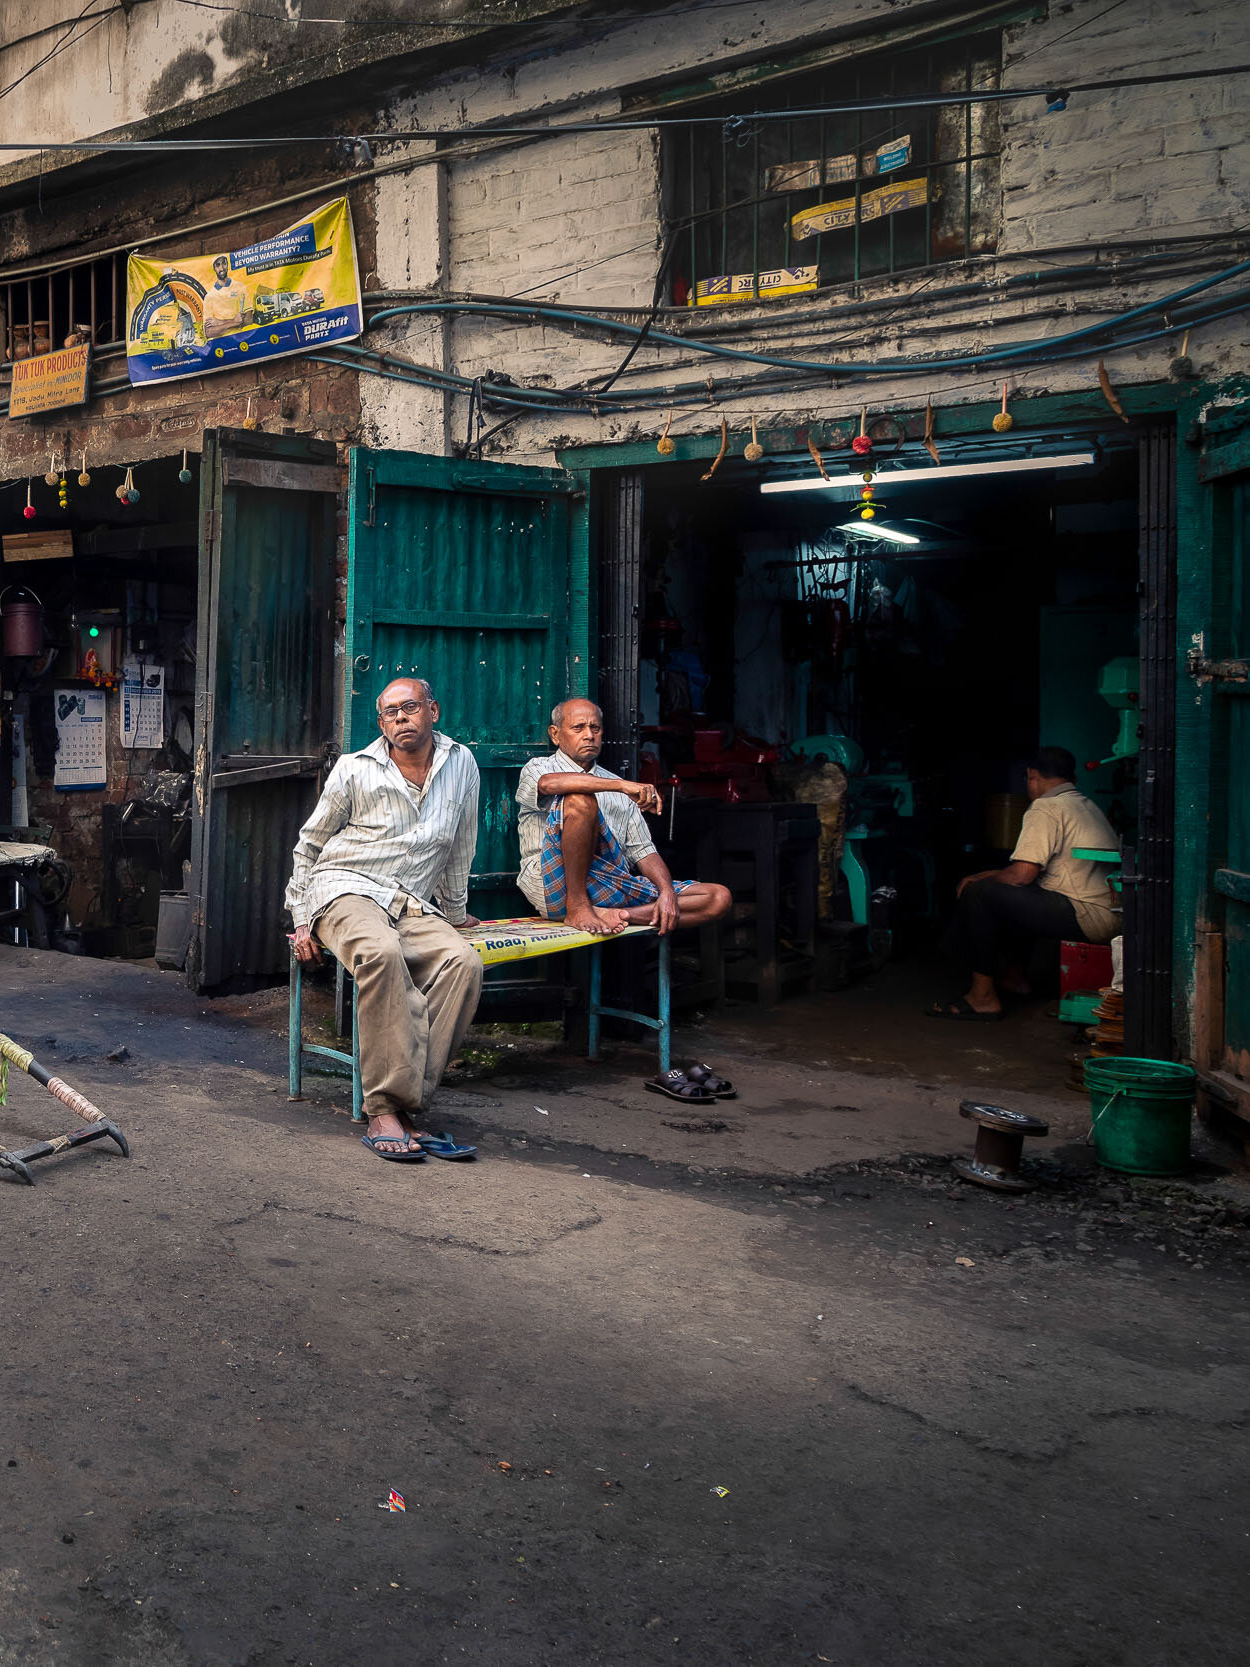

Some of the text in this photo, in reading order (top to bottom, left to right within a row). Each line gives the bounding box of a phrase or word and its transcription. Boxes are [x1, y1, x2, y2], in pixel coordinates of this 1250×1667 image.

[823, 213, 850, 226] CITY
[234, 246, 259, 258] VEHICLE
[260, 235, 309, 252] PERFORMANCE
[235, 246, 301, 267] BEYOND WARRANTY?
[760, 275, 781, 286] CITY
[305, 330, 330, 341] PARTS
[14, 350, 87, 381] TUK TUK PRODUCTS
[29, 394, 45, 402] Jadu
[66, 387, 80, 395] Lane
